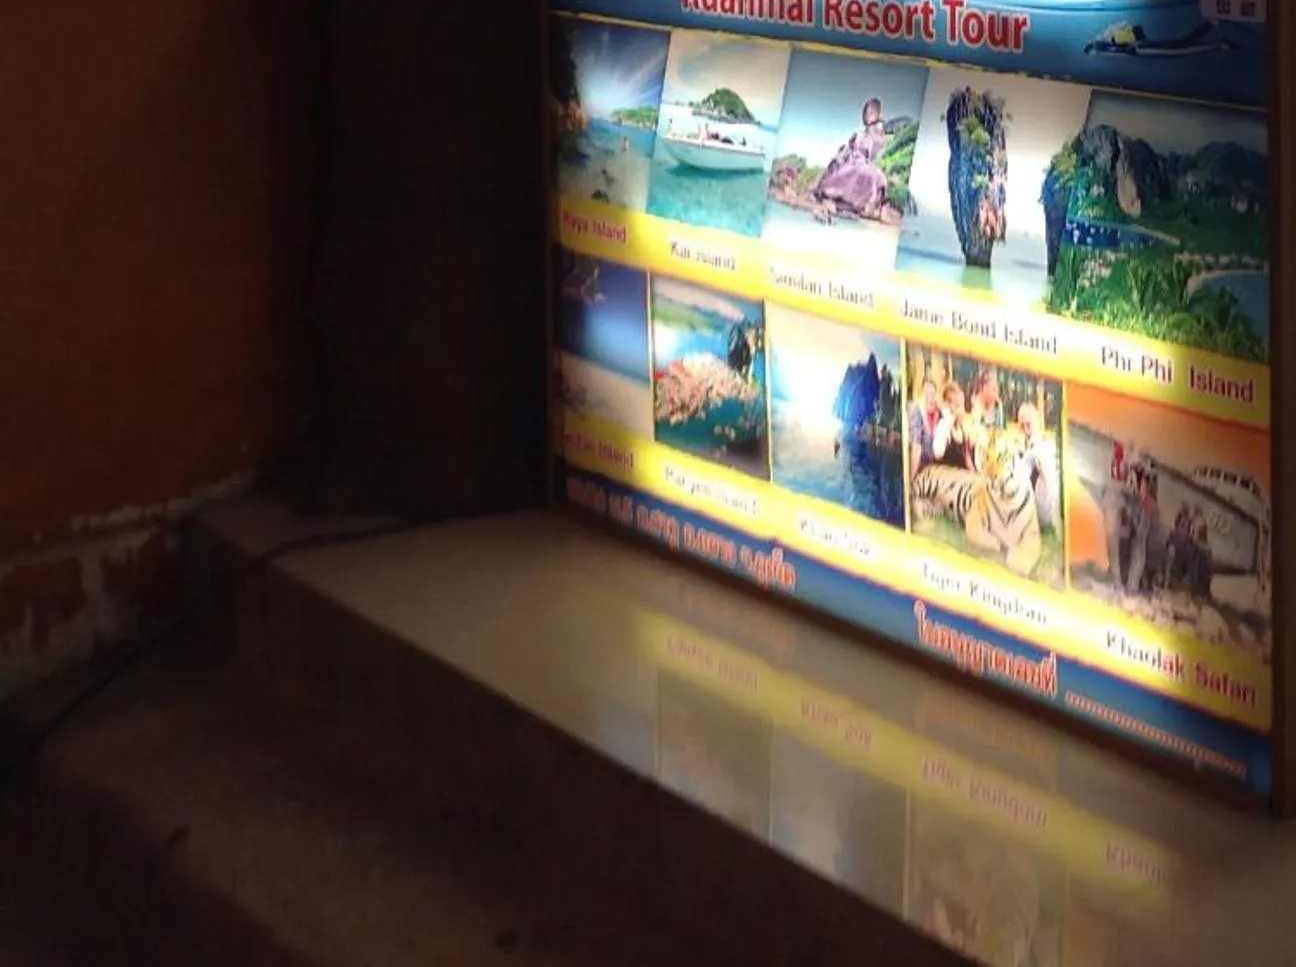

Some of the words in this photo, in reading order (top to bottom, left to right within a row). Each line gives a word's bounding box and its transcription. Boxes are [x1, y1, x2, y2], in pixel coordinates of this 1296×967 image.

[950, 309, 997, 341] Bond
[1002, 322, 1058, 355] Island
[1100, 344, 1132, 374] Phi
[1140, 354, 1174, 386] Phi
[1187, 364, 1256, 404] Island
[1194, 662, 1257, 708] Safari
